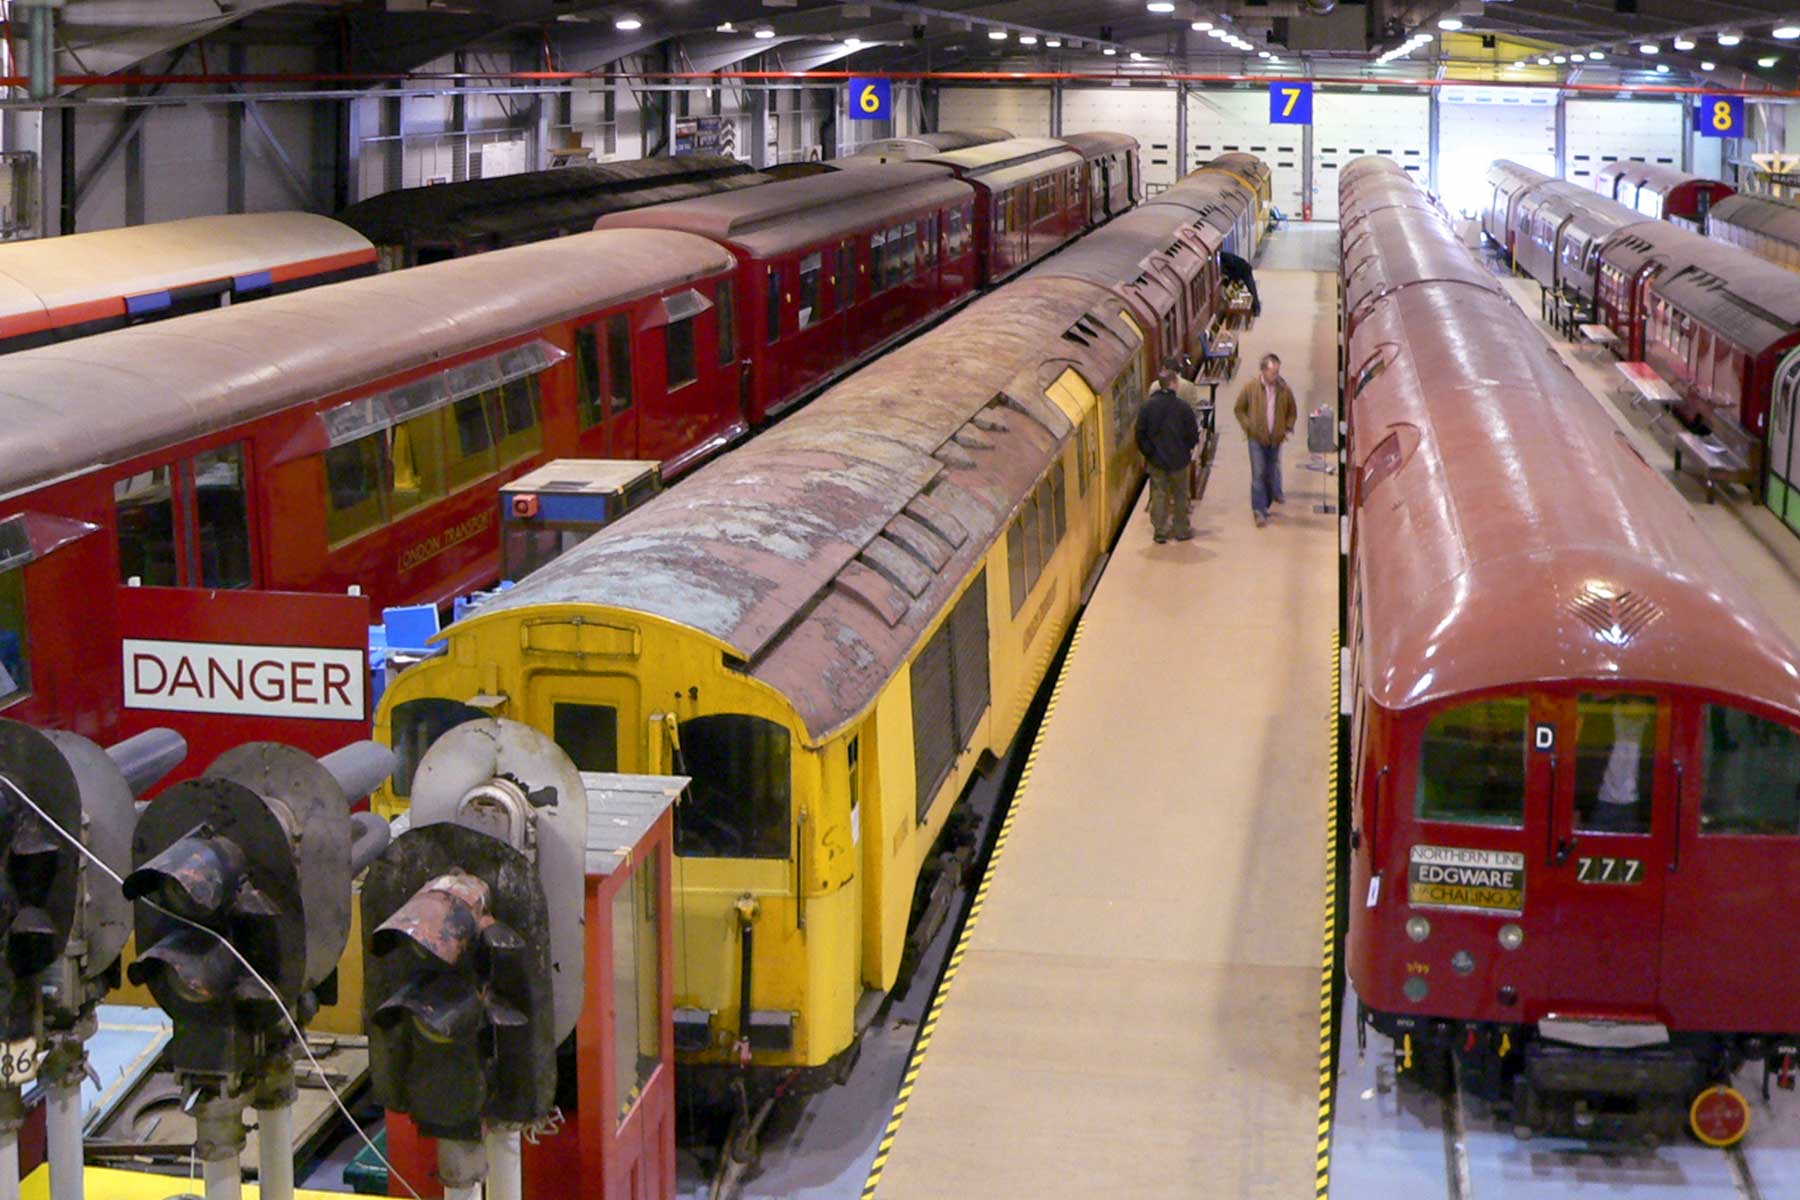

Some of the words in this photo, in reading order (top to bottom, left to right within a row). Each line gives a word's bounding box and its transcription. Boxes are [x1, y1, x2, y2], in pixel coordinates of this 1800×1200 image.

[860, 85, 880, 113] 6
[1282, 88, 1301, 117] 7
[1713, 101, 1732, 131] 8
[133, 652, 352, 706] DANGER
[1536, 727, 1553, 748] D
[1412, 847, 1489, 864] NORTHERN
[1495, 853, 1522, 866] LINE
[1577, 857, 1639, 882] 777
[1419, 865, 1514, 888] EDGWARE
